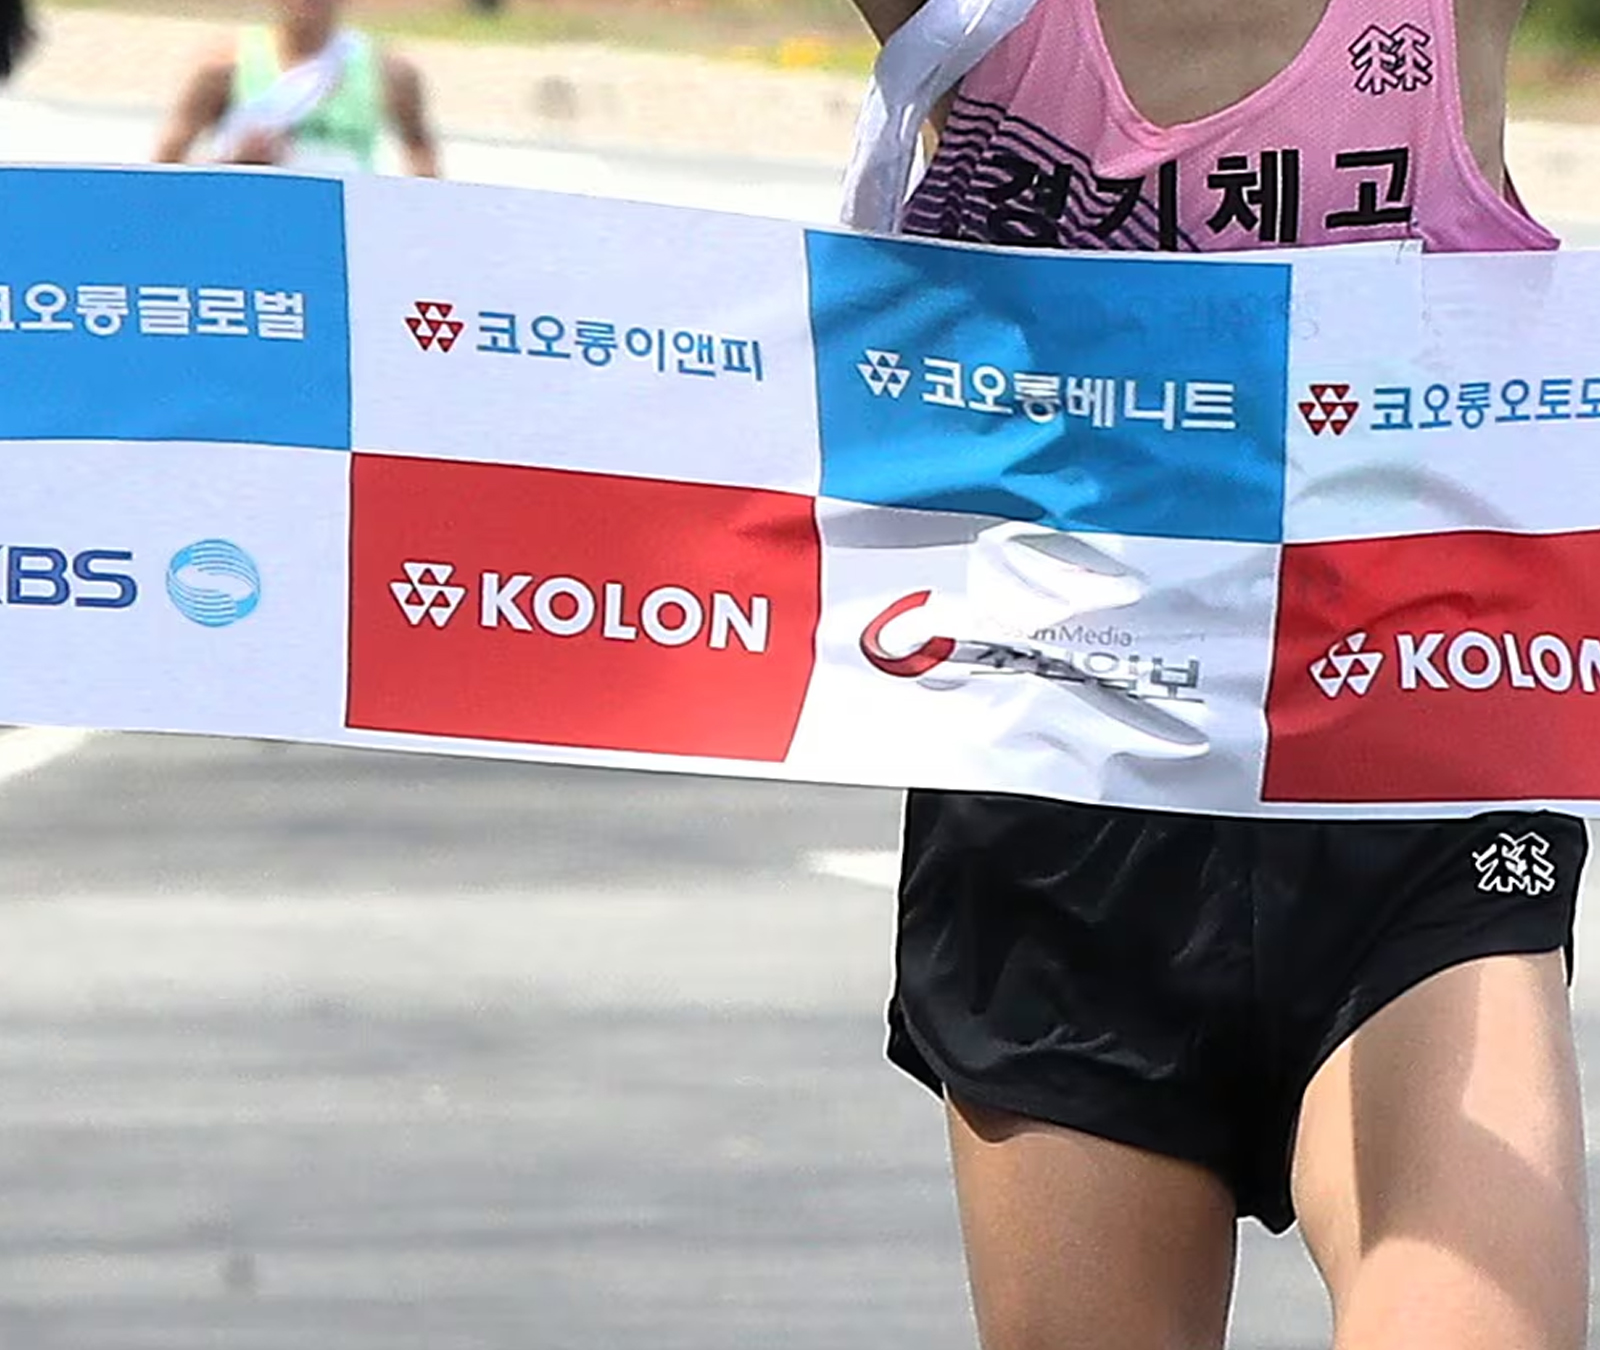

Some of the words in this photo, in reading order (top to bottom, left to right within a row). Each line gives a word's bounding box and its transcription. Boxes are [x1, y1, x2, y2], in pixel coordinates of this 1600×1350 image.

[978, 147, 1412, 249] 경기체고
[475, 309, 765, 381] 코오롱이앤피
[921, 356, 1237, 431] 코오롱베니트
[0, 544, 138, 610] BS
[479, 570, 770, 654] KOLON
